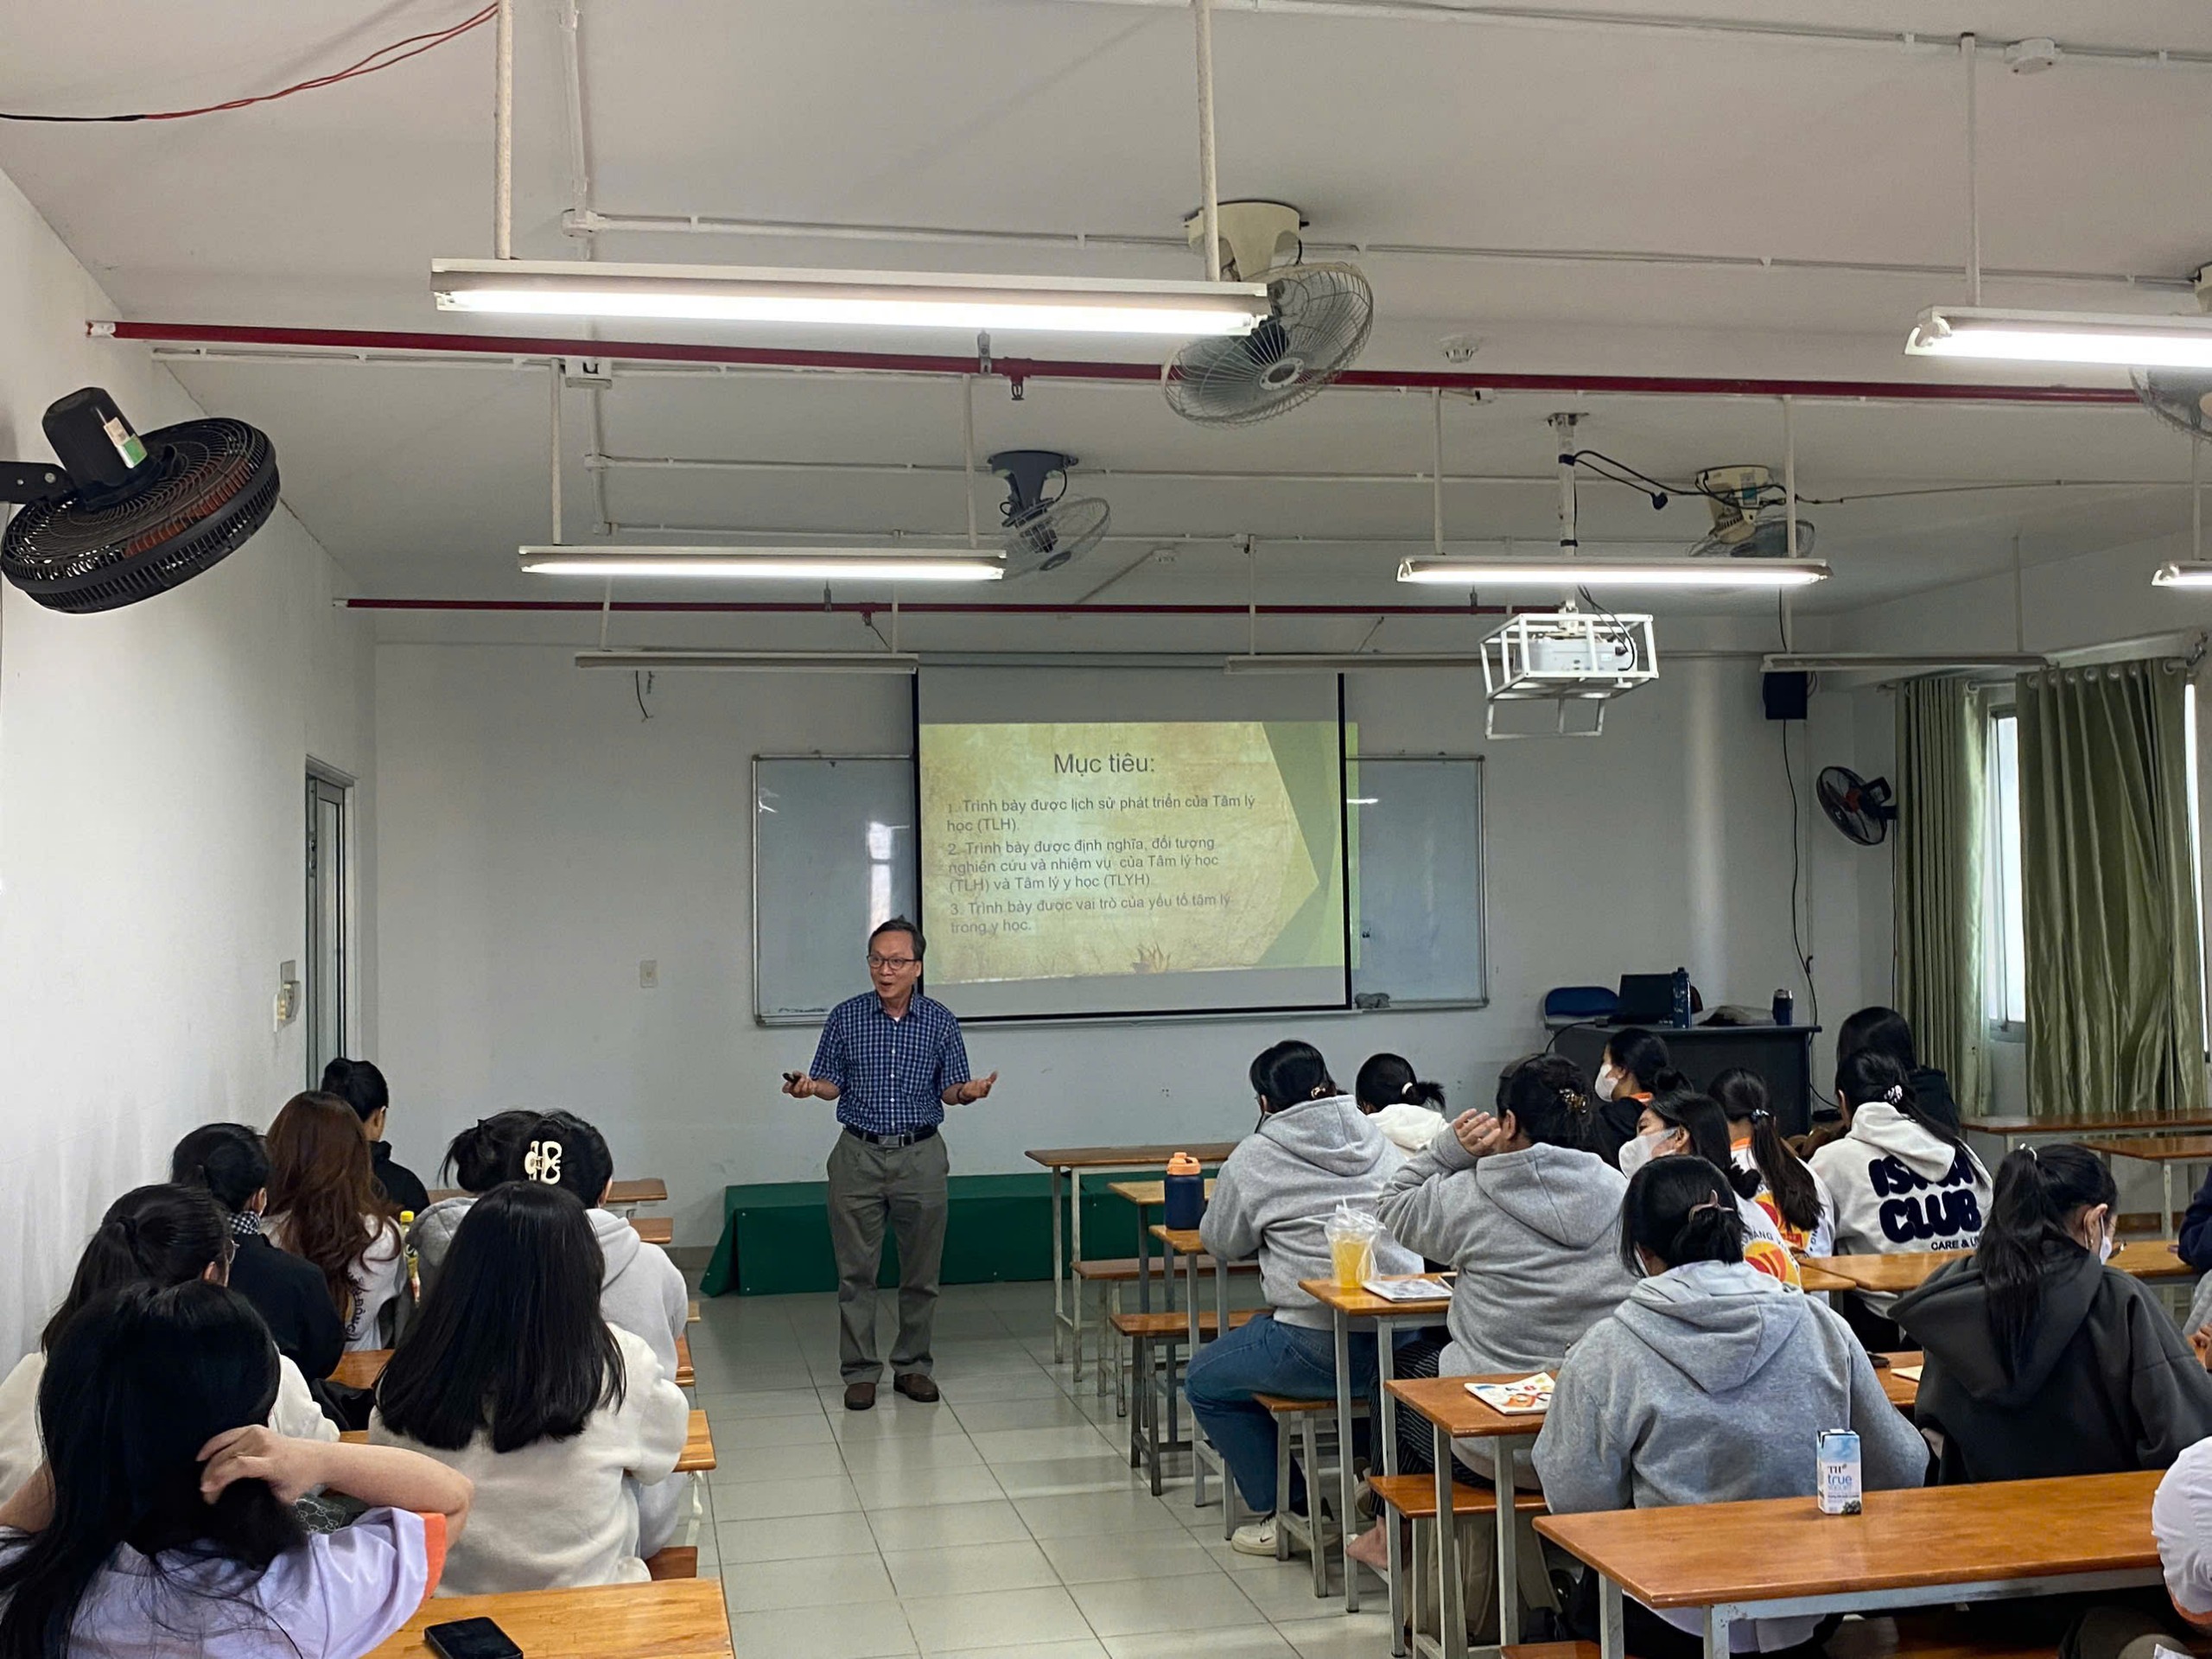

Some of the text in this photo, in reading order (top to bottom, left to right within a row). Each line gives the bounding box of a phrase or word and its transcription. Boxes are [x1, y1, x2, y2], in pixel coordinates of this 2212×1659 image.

[1054, 753, 1154, 777] Mục tiêu:
[963, 798, 997, 812] Trình
[1002, 798, 1026, 814] bày
[1031, 799, 1067, 812] được
[1071, 798, 1093, 812] lịch
[1098, 796, 1116, 810] sử
[1120, 796, 1148, 811] phát
[1153, 792, 1180, 808] triển
[1185, 794, 1208, 808] của
[1212, 794, 1240, 807] Tâm
[1244, 794, 1255, 809] lý
[947, 819, 972, 834] học
[965, 842, 1001, 855] Trình
[1006, 841, 1029, 855] bày
[1034, 840, 1071, 854] được
[1074, 839, 1102, 854] định
[1152, 835, 1171, 849] đối
[1176, 837, 1215, 850] tượng
[949, 854, 1218, 876] nghiên cứu và nhiệm vụ của Tâm lý học
[950, 878, 989, 895] (TLH)
[994, 877, 1010, 890] và
[1014, 875, 1044, 889] Tâm
[1048, 875, 1059, 891] lý
[1064, 879, 1071, 890] y
[1075, 875, 1100, 889] học
[968, 901, 1002, 915] Trình
[1007, 900, 1032, 915] bày
[1036, 899, 1072, 912] được
[1076, 898, 1095, 910] vai
[1099, 897, 1116, 909] trò
[1121, 895, 1144, 908] của
[1192, 893, 1217, 906] tâm
[951, 922, 987, 935] trong
[991, 922, 999, 934] y
[1868, 1150, 1974, 1198] ISA
[1879, 1189, 1982, 1243] CLUB
[1931, 1240, 1959, 1250] CARE
[1827, 1474, 1853, 1485] true
